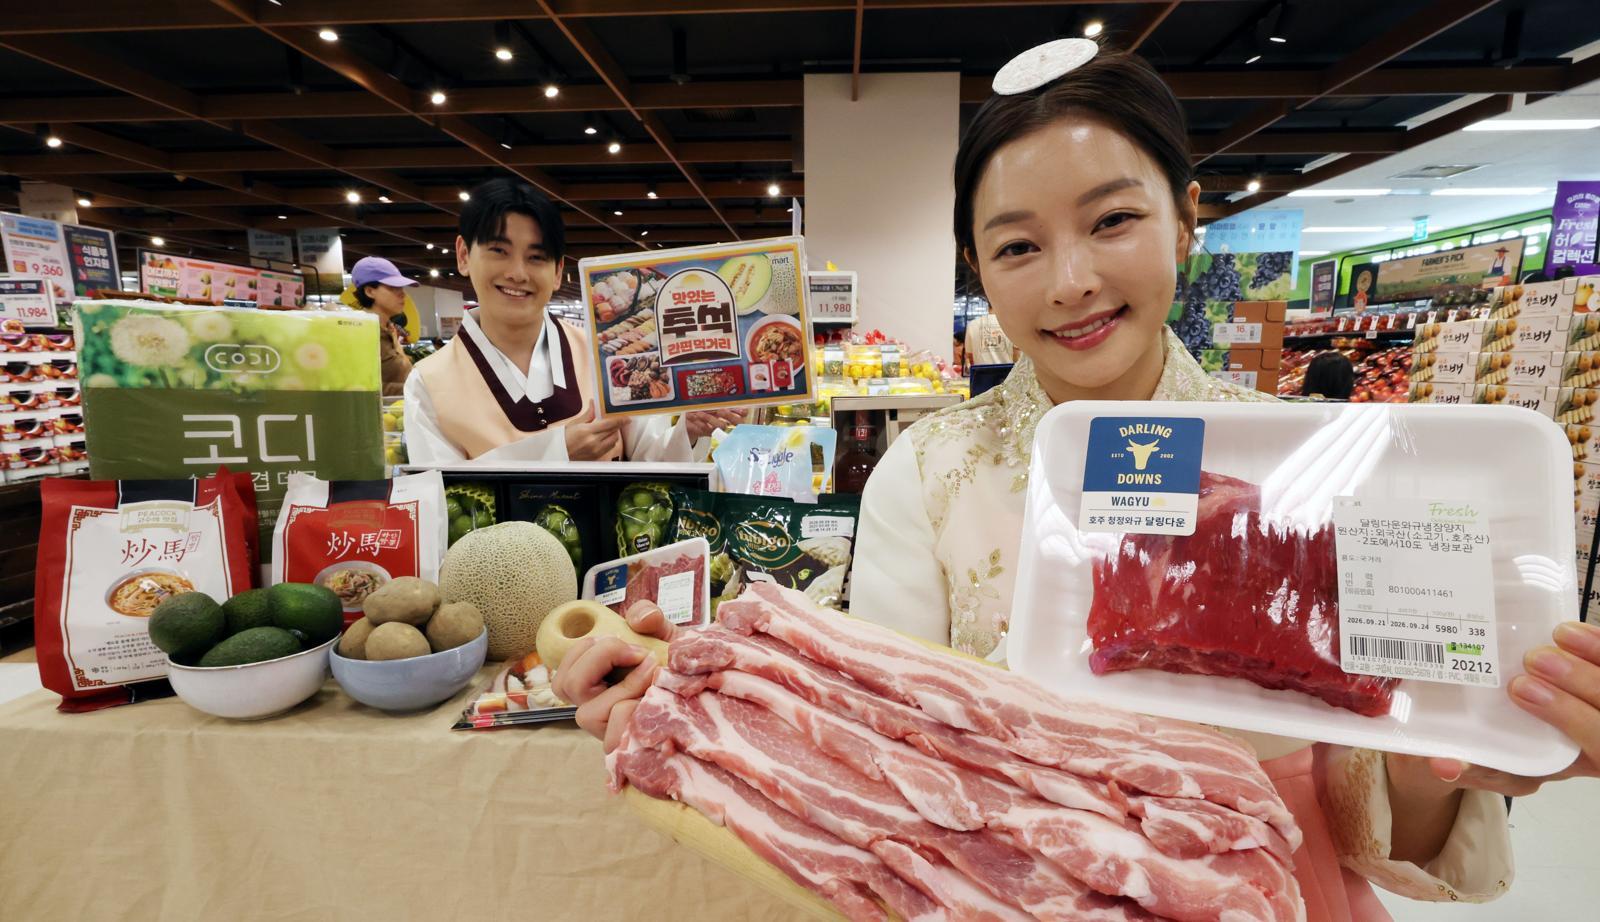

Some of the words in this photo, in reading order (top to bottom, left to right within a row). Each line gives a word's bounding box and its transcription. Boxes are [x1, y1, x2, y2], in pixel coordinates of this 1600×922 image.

[1450, 253, 1465, 262] PICK
[1552, 249, 1595, 264] 컬렉션
[672, 289, 715, 305] 맛있는
[663, 302, 733, 338] 추석
[667, 338, 731, 356] 간편먹거리
[1119, 423, 1173, 439] DARLING
[183, 414, 315, 465] 코디
[1117, 473, 1162, 485] DOWNS
[1111, 496, 1150, 507] WAGYU
[1428, 502, 1479, 517] Fresh
[1088, 516, 1105, 525] 호주
[1107, 516, 1143, 526] 청정와규
[1145, 515, 1186, 528] 달링다운
[121, 538, 186, 567] 炒馬
[326, 531, 381, 560] 炒馬
[1429, 541, 1473, 553] 냉장보관
[1388, 585, 1454, 599] 801000411461
[1347, 617, 1386, 627] 2026.09.21
[1390, 620, 1429, 631] 2026.09.24
[1435, 624, 1458, 635] 5980
[1468, 627, 1486, 637] 338
[1452, 658, 1493, 674] 20212
